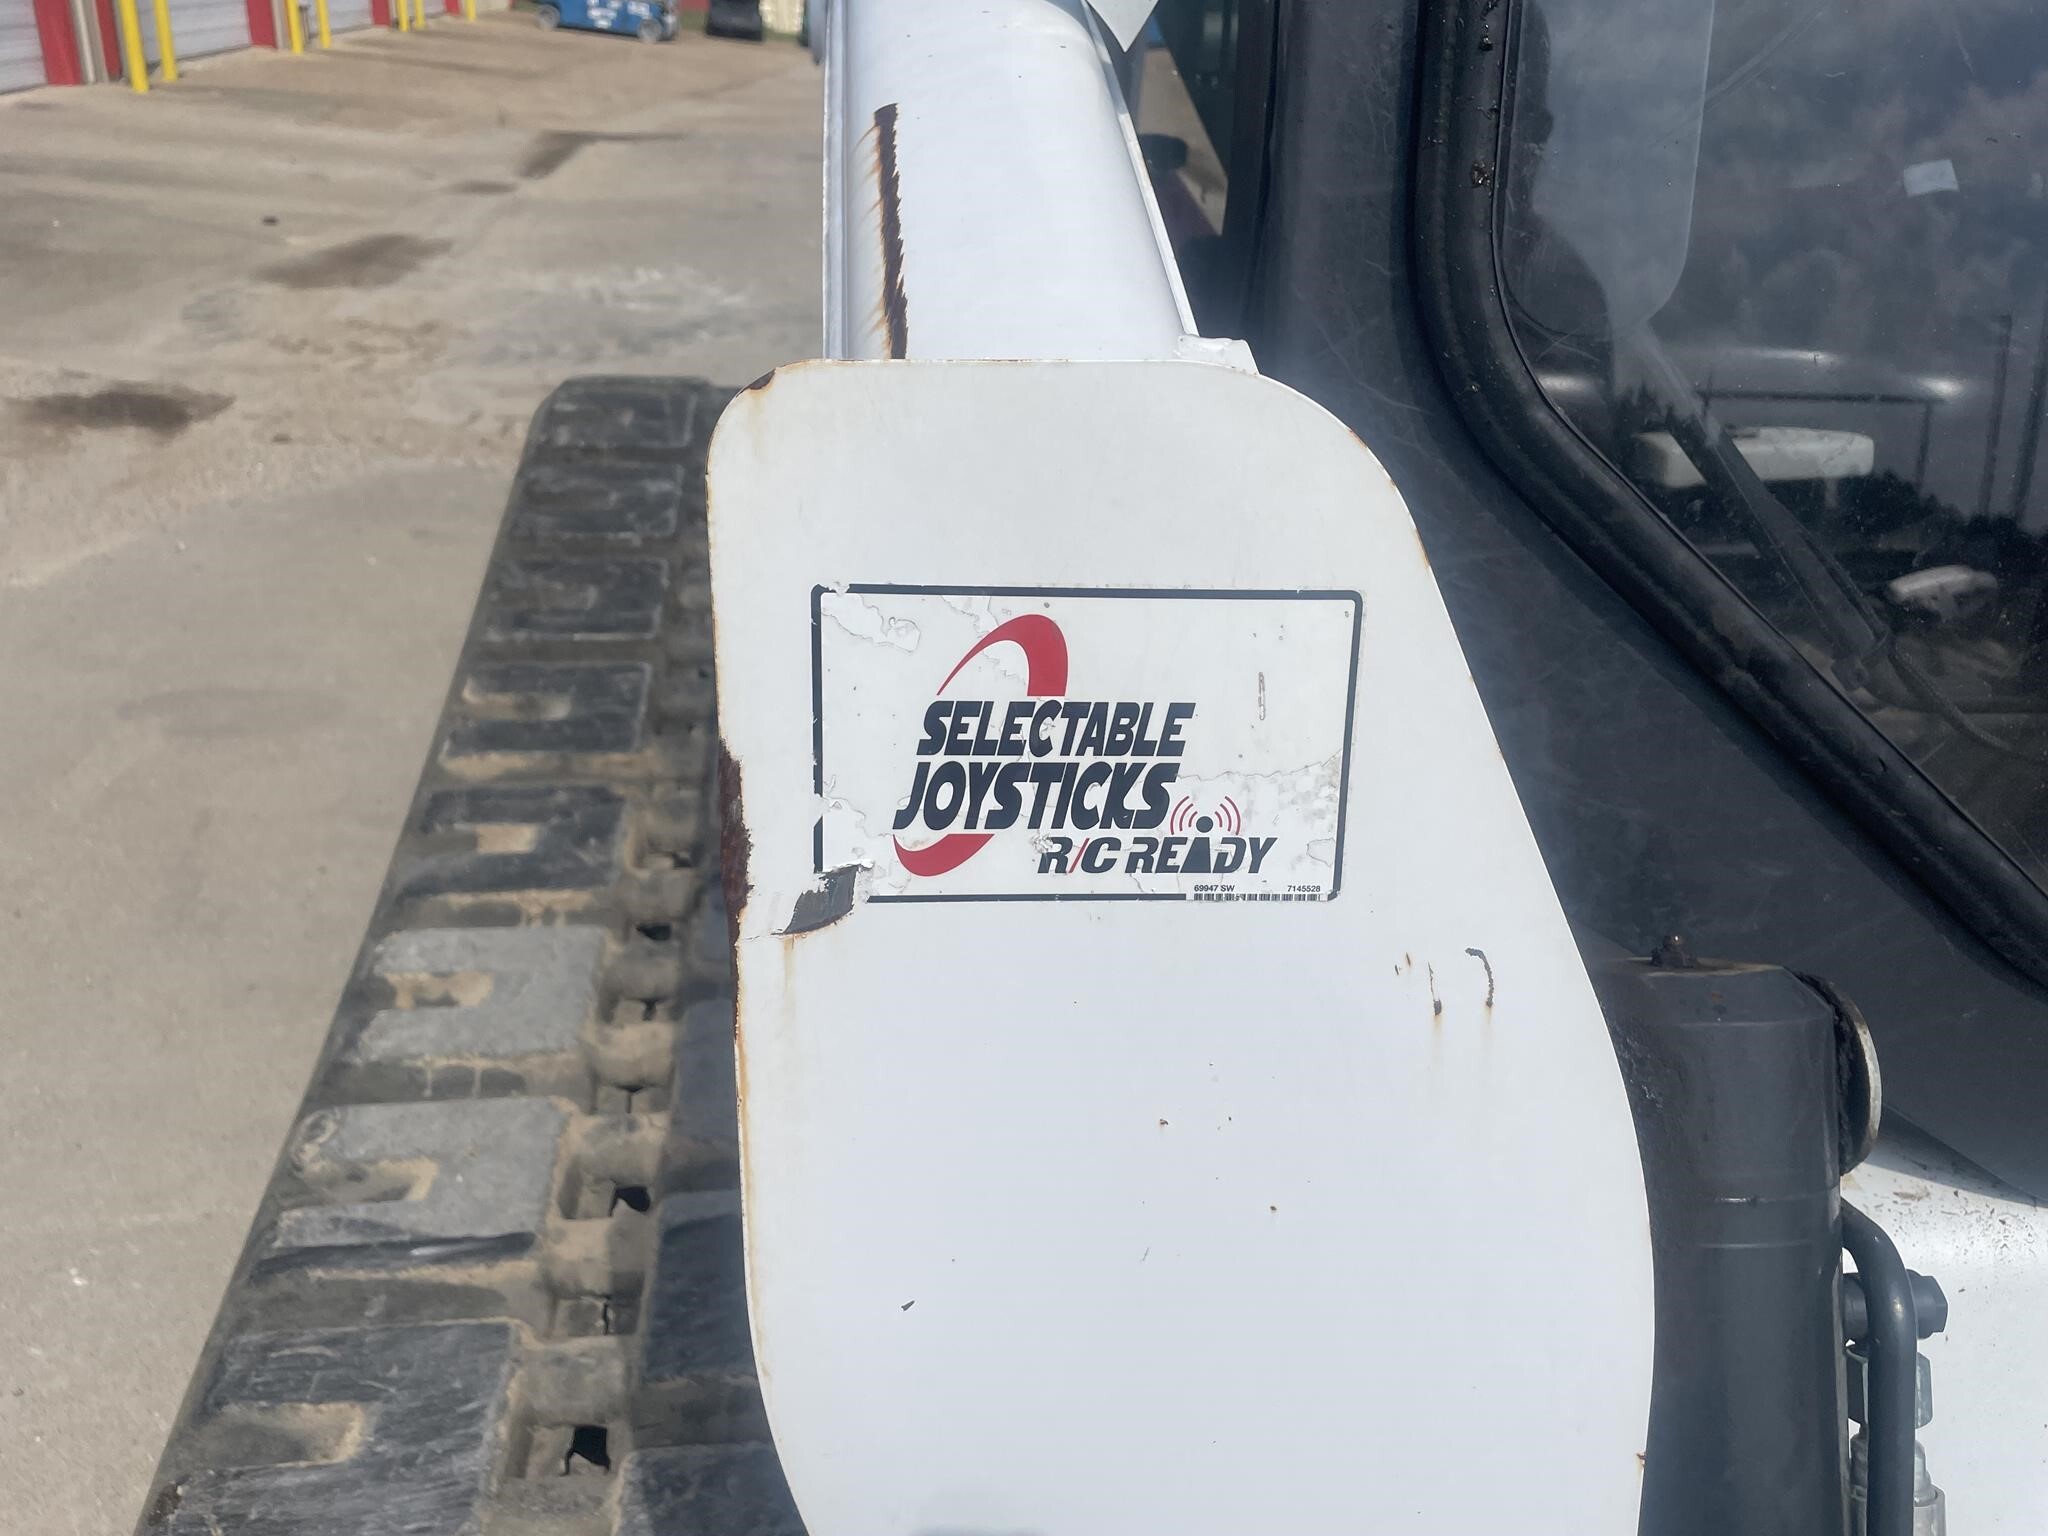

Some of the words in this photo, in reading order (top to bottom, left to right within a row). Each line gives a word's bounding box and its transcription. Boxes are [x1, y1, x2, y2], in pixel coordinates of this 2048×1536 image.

[916, 699, 1197, 758] SELECTABLE
[892, 760, 1181, 831] JOYSTICKS
[1037, 836, 1122, 874] R/C
[1125, 836, 1278, 874] READY
[1193, 884, 1219, 892] 69947
[1220, 884, 1235, 892] SW
[1287, 885, 1321, 893] 7145528
